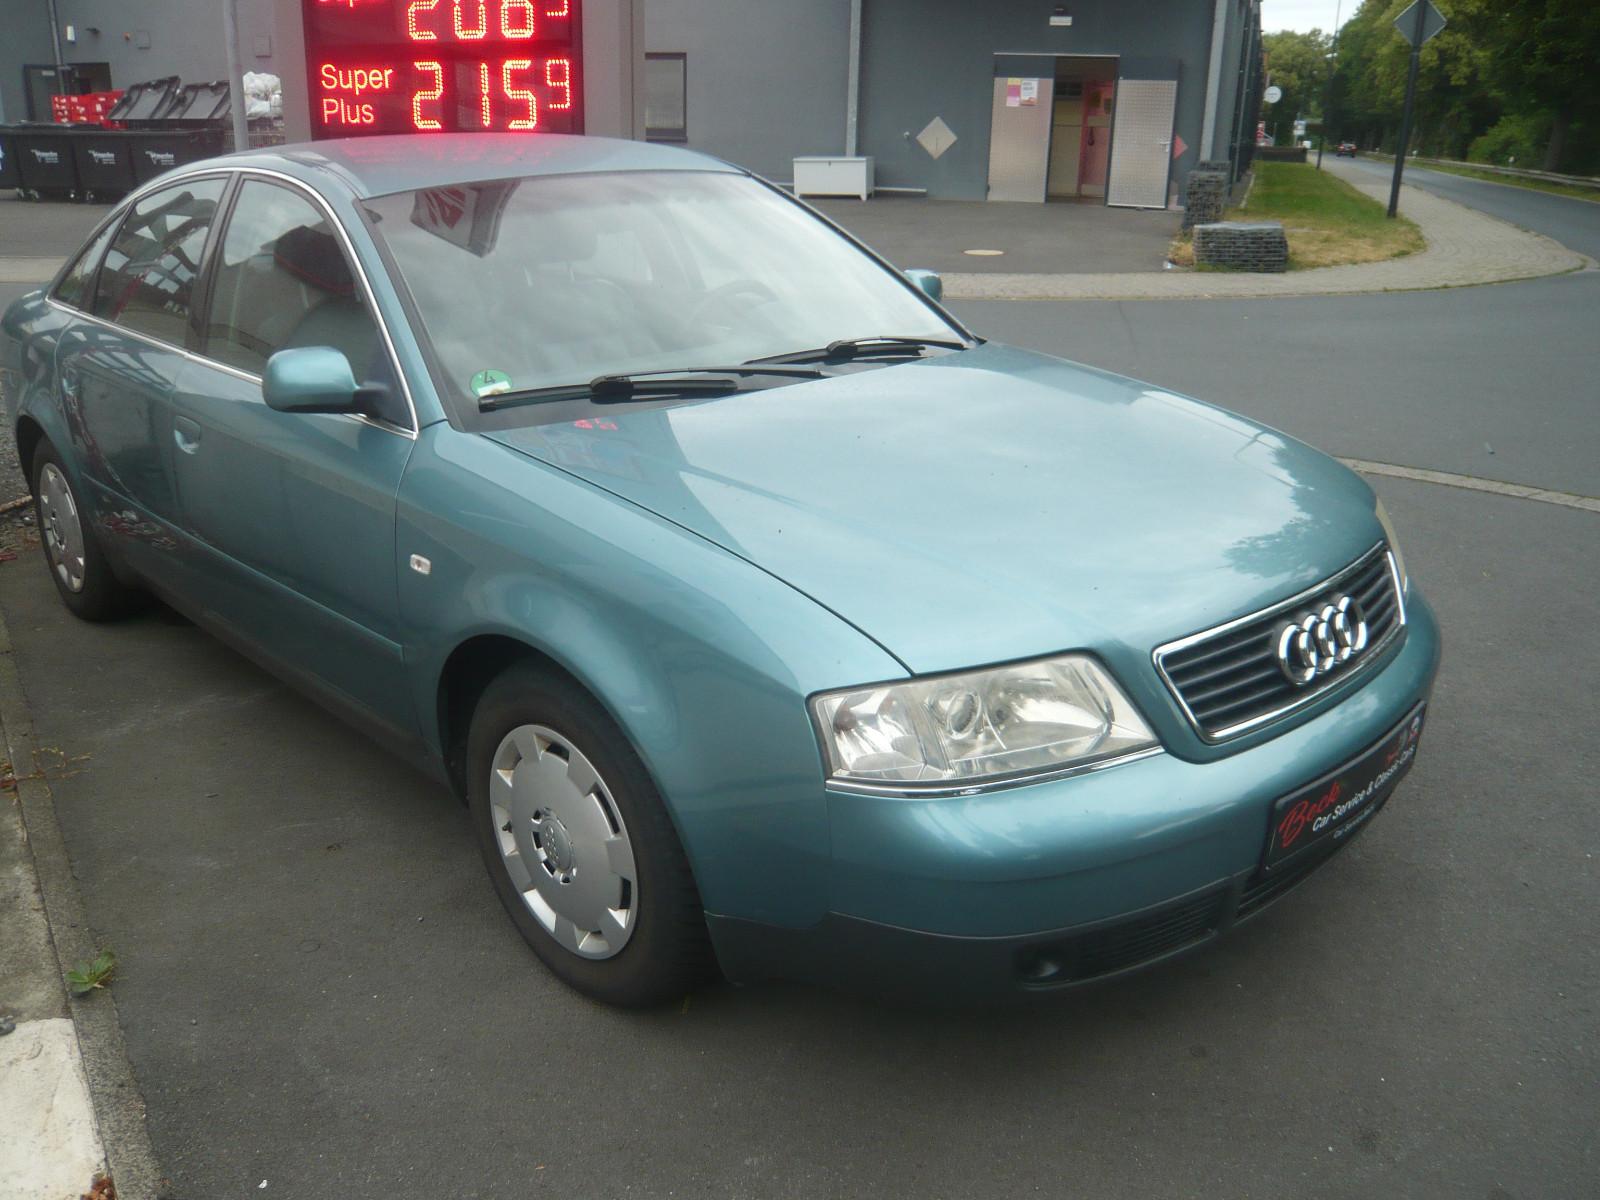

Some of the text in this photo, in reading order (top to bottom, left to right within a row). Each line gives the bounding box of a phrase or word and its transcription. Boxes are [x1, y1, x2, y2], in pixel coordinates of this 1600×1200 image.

[321, 63, 394, 96] Super
[322, 97, 375, 124] Plus
[483, 371, 496, 385] 4
[1312, 812, 1333, 832] Car
[1332, 789, 1366, 820] Service
